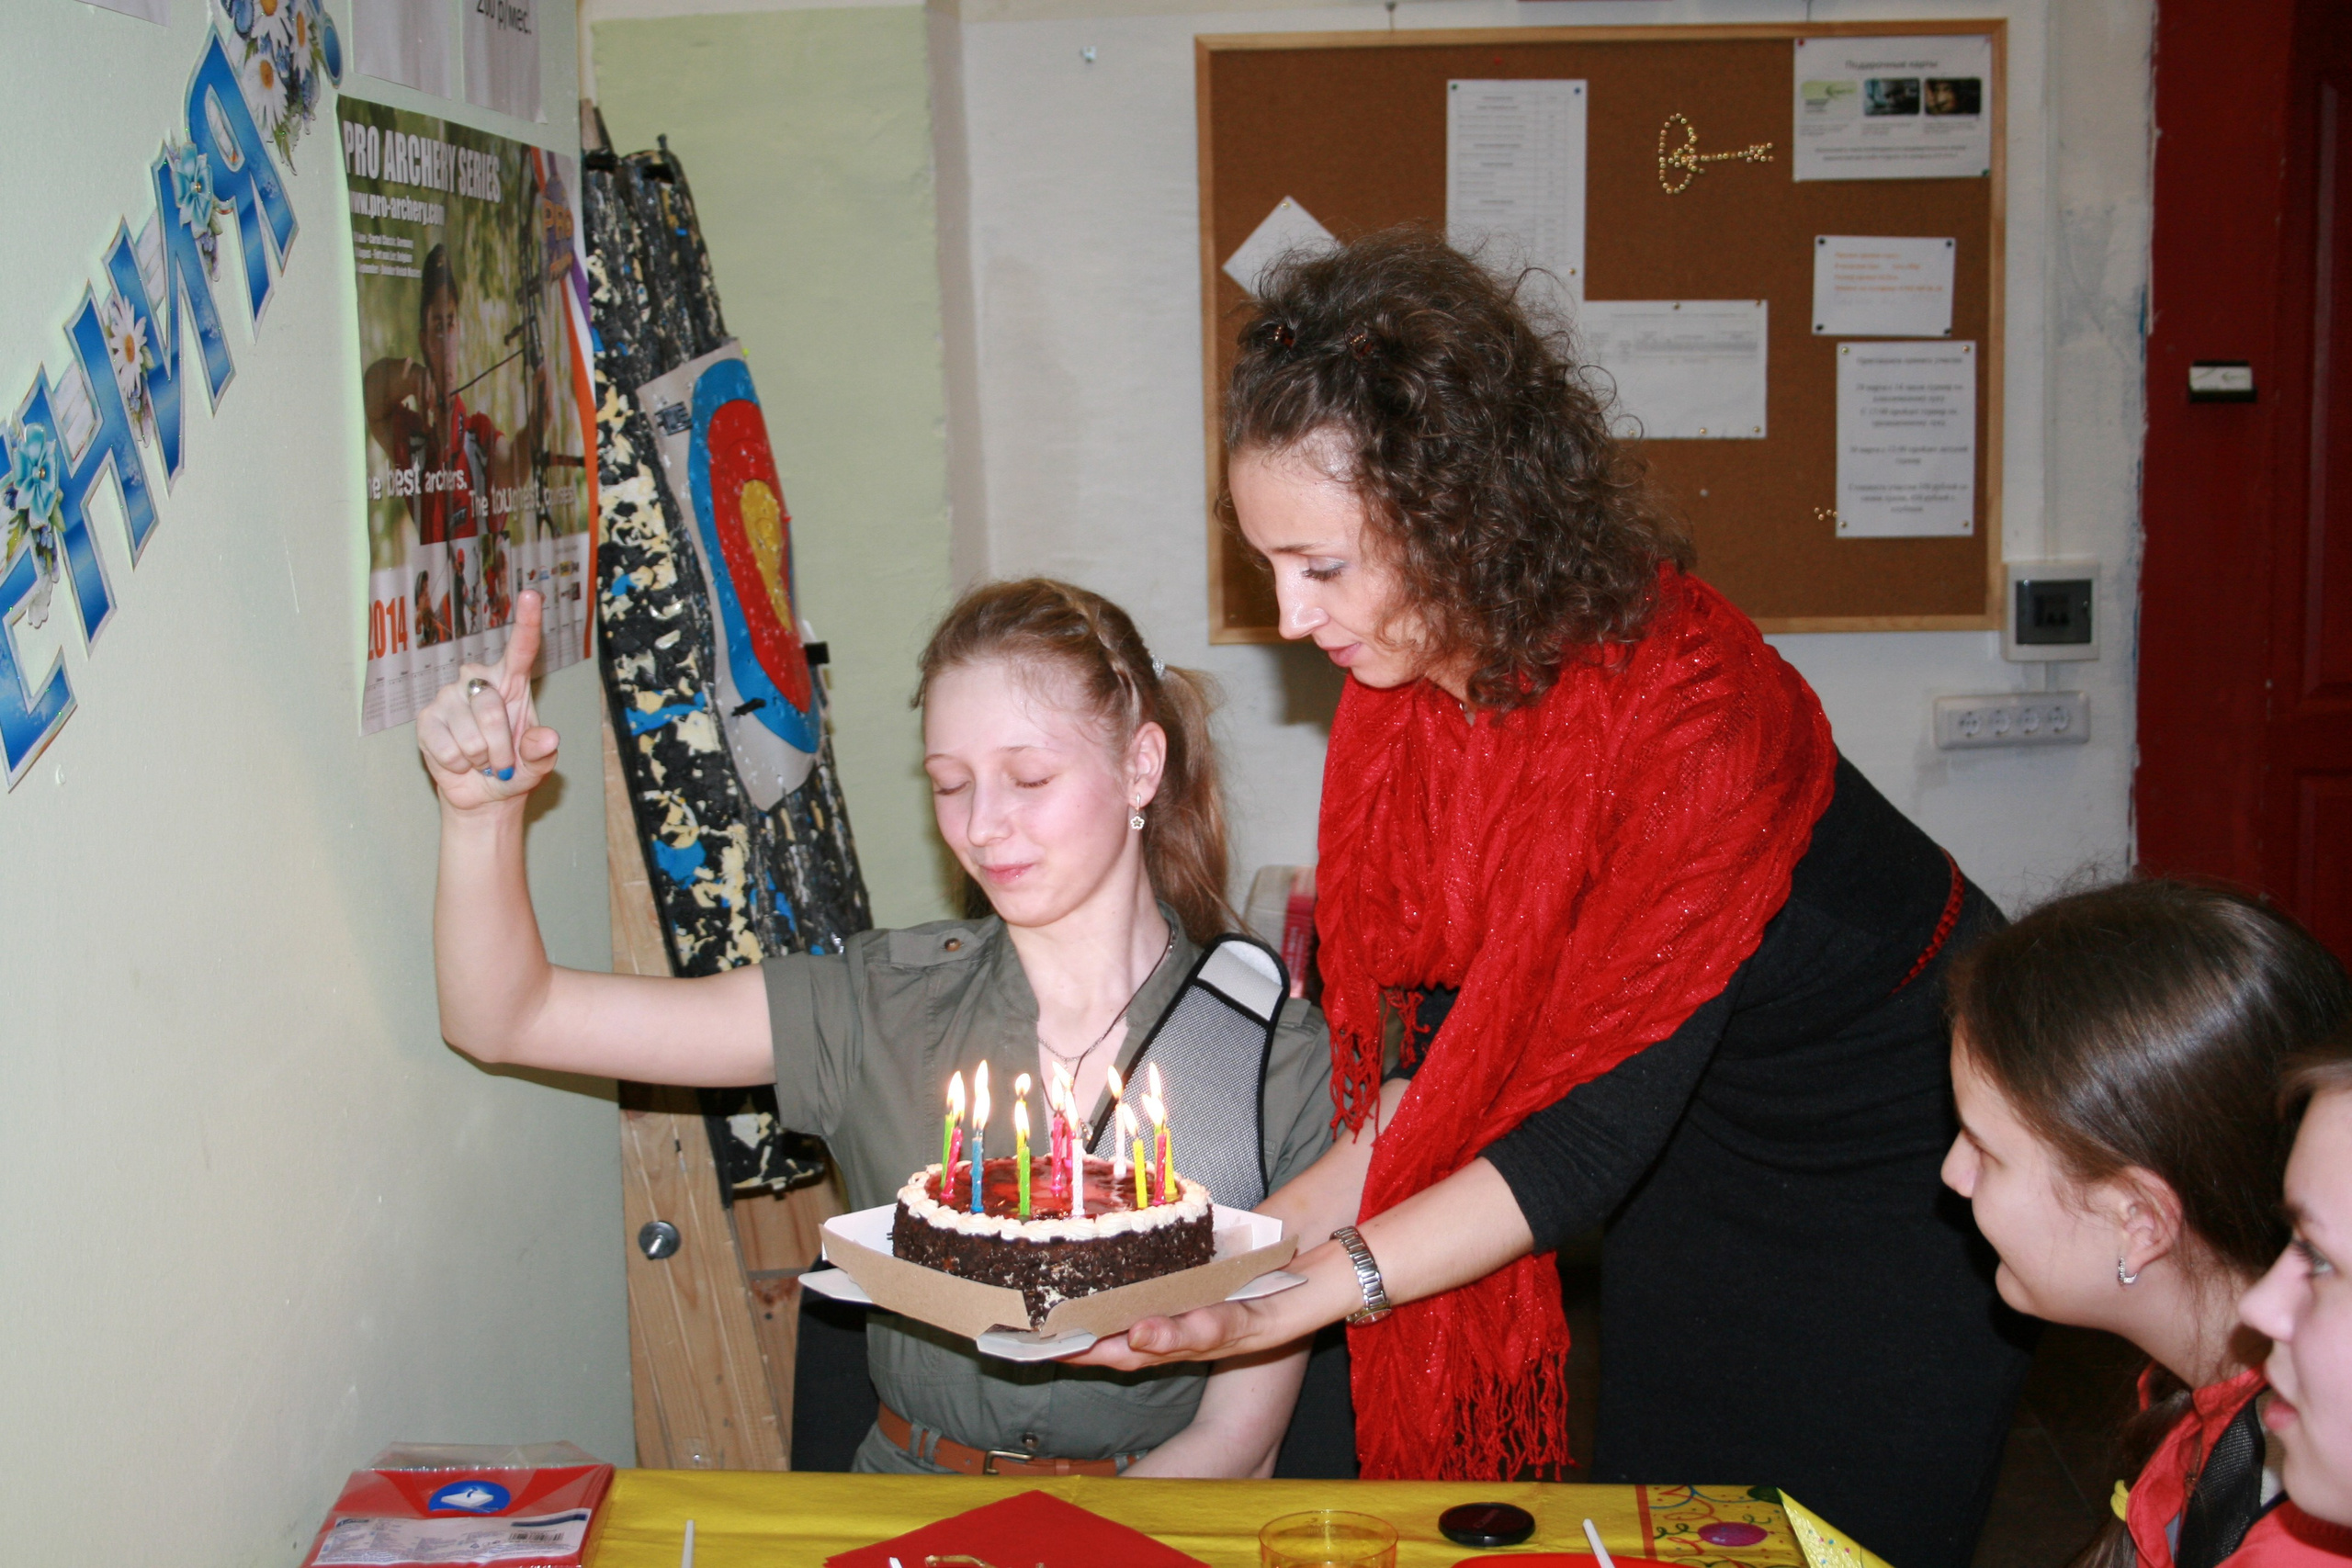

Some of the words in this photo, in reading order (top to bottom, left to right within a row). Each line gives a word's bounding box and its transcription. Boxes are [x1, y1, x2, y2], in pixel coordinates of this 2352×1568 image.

[343, 120, 379, 180] PRO
[384, 130, 457, 194] ARCHERY
[458, 147, 502, 204] SERIES
[386, 457, 422, 497] best
[424, 461, 467, 494] archers.
[469, 489, 489, 519] The
